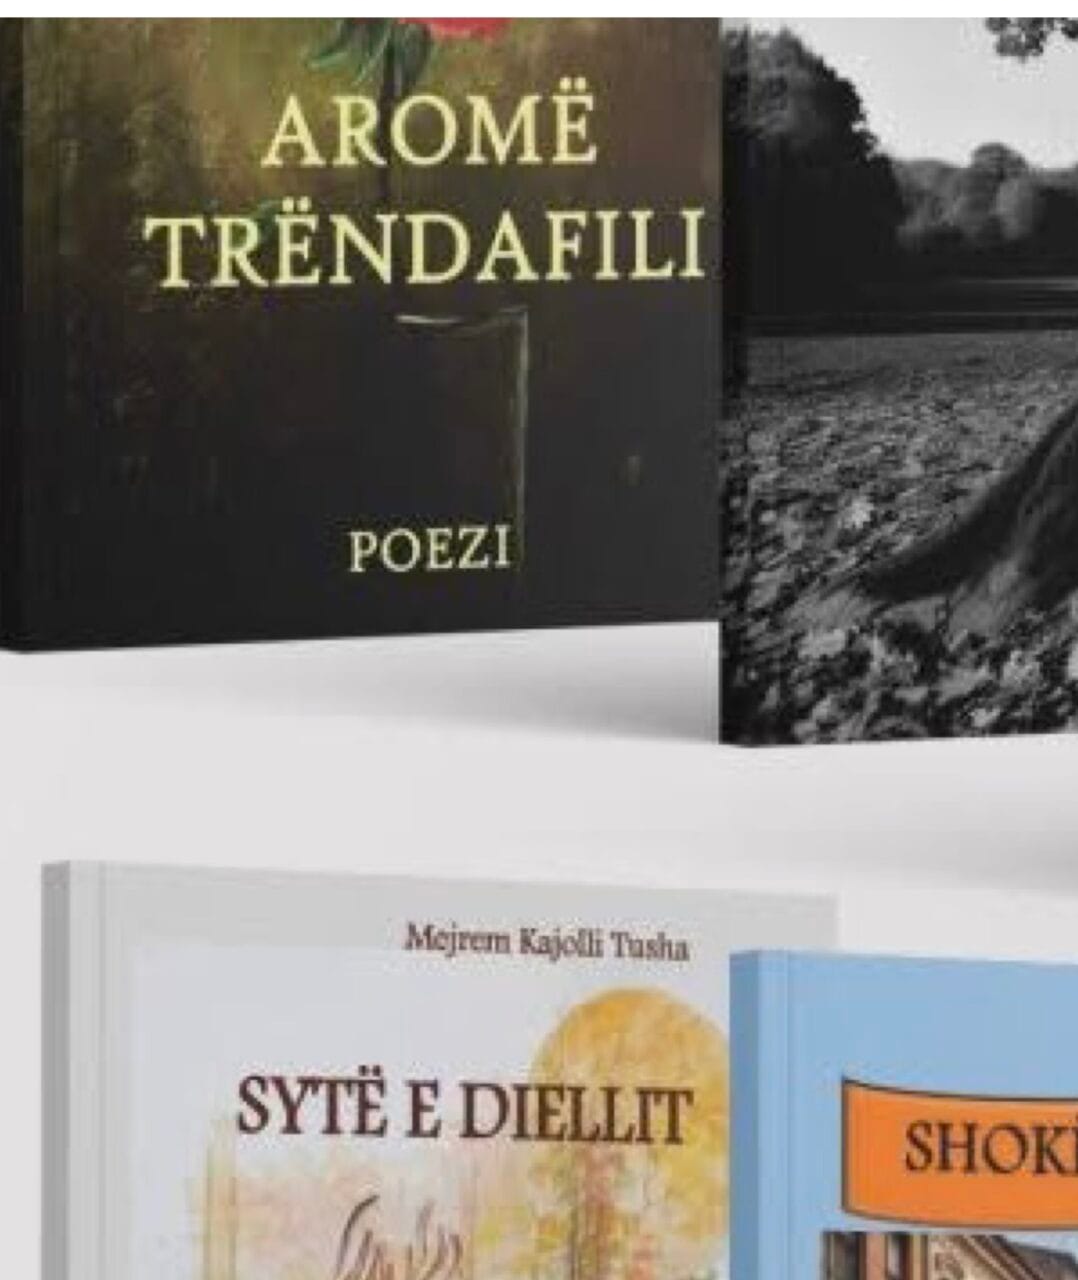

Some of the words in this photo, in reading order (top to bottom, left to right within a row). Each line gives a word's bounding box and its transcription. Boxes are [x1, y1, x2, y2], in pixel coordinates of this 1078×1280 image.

[261, 77, 598, 166] AROMË
[143, 197, 706, 289] TRËNDAFILI
[349, 524, 511, 573] POEZI
[404, 922, 511, 958] Mejrem
[610, 930, 690, 962] Tusha
[236, 1065, 388, 1136] SYTË
[405, 1080, 440, 1139] E
[459, 1081, 695, 1146] DIELLIT
